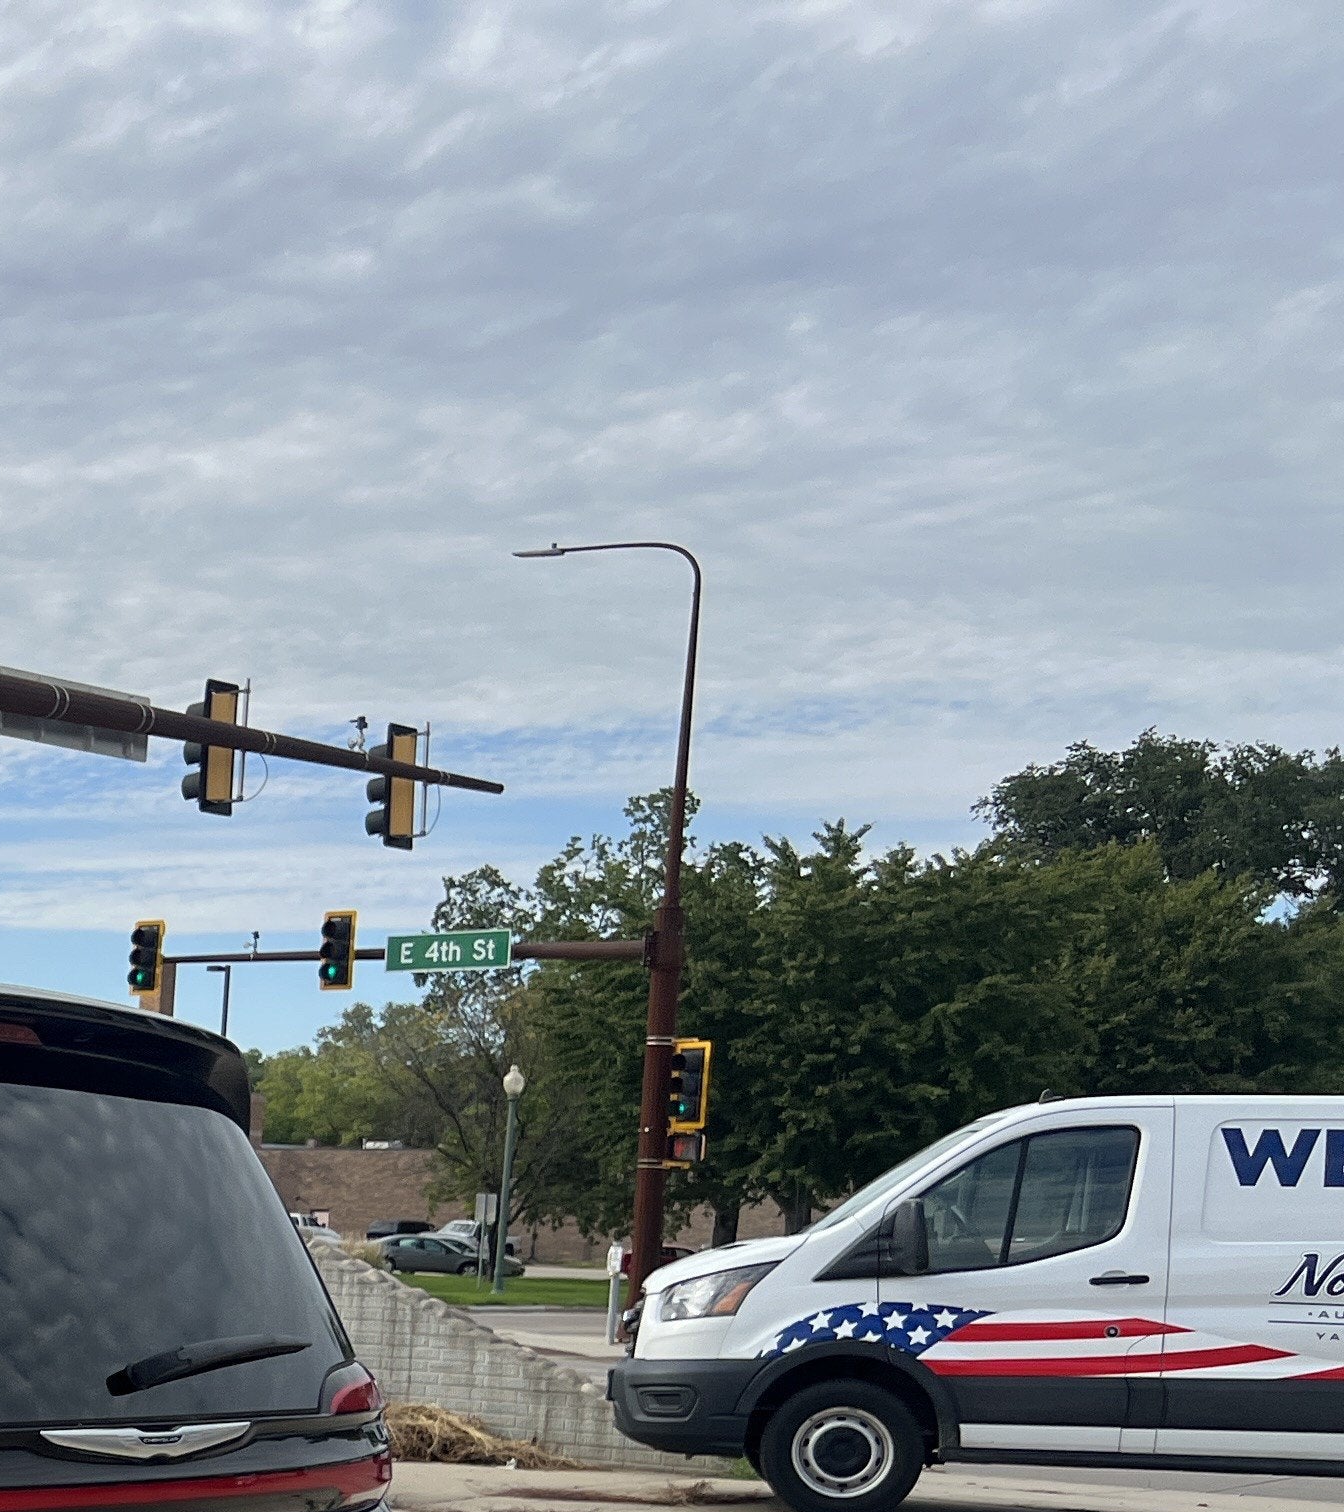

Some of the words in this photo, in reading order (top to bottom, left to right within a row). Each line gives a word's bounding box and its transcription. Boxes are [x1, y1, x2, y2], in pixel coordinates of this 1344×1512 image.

[400, 942, 414, 964] E
[425, 941, 461, 963] 4th
[473, 939, 495, 961] St
